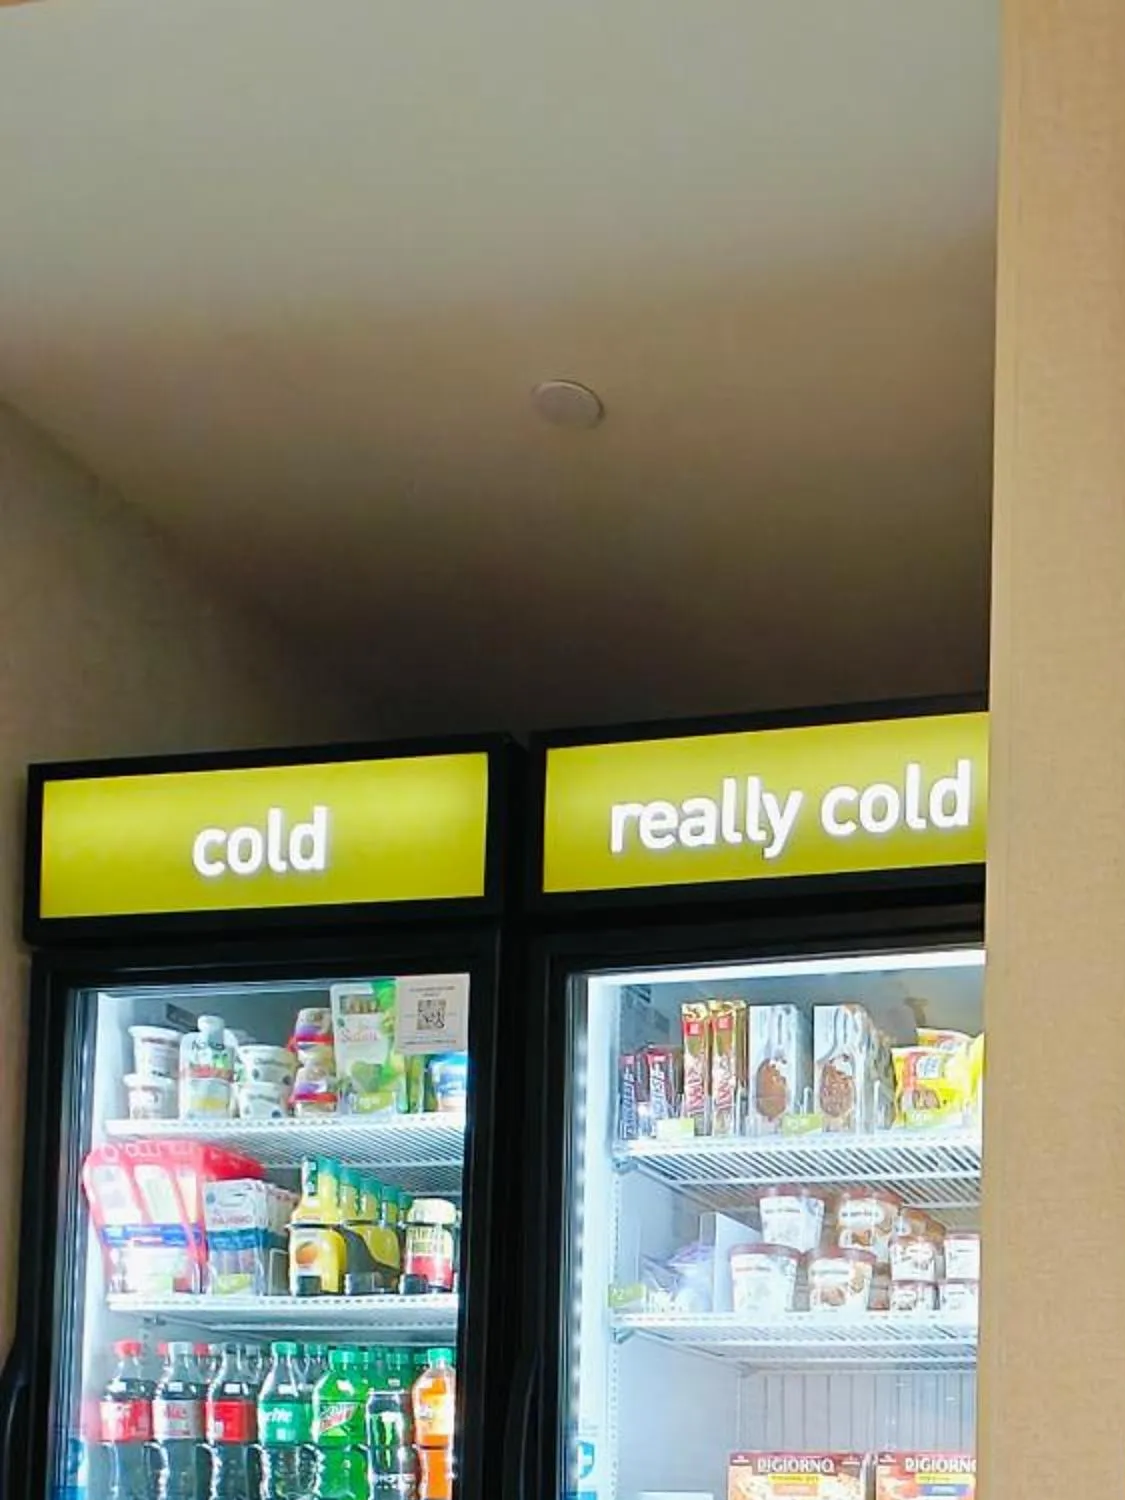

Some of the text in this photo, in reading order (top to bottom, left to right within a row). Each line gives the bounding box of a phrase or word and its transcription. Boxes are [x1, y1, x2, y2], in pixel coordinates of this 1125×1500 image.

[192, 807, 328, 877] cold
[610, 760, 973, 860] really cold
